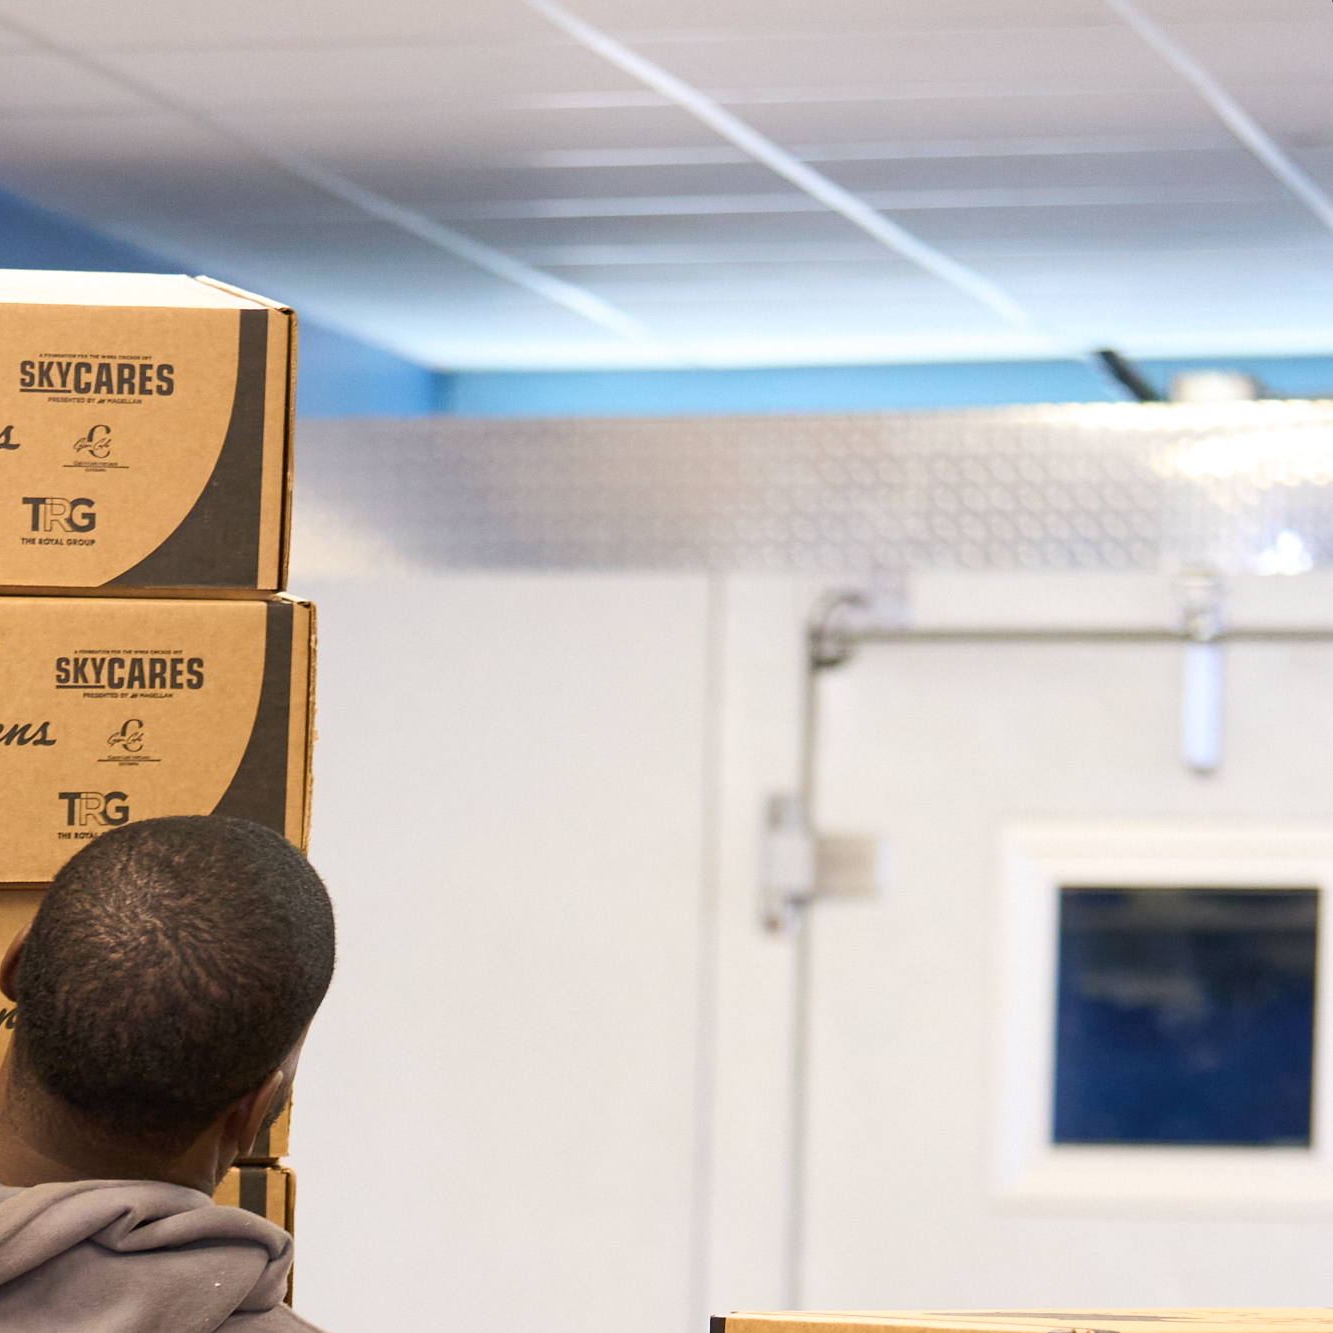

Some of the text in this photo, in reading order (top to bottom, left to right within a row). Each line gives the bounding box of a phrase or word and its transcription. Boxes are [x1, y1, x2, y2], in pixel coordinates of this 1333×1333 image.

[19, 359, 175, 396] SKYCARES
[21, 496, 96, 533] TRG
[21, 537, 96, 546] THE ROYAL GROUP
[55, 656, 205, 690] SKYCARES
[58, 790, 130, 827] TRG
[57, 832, 72, 840] THE
